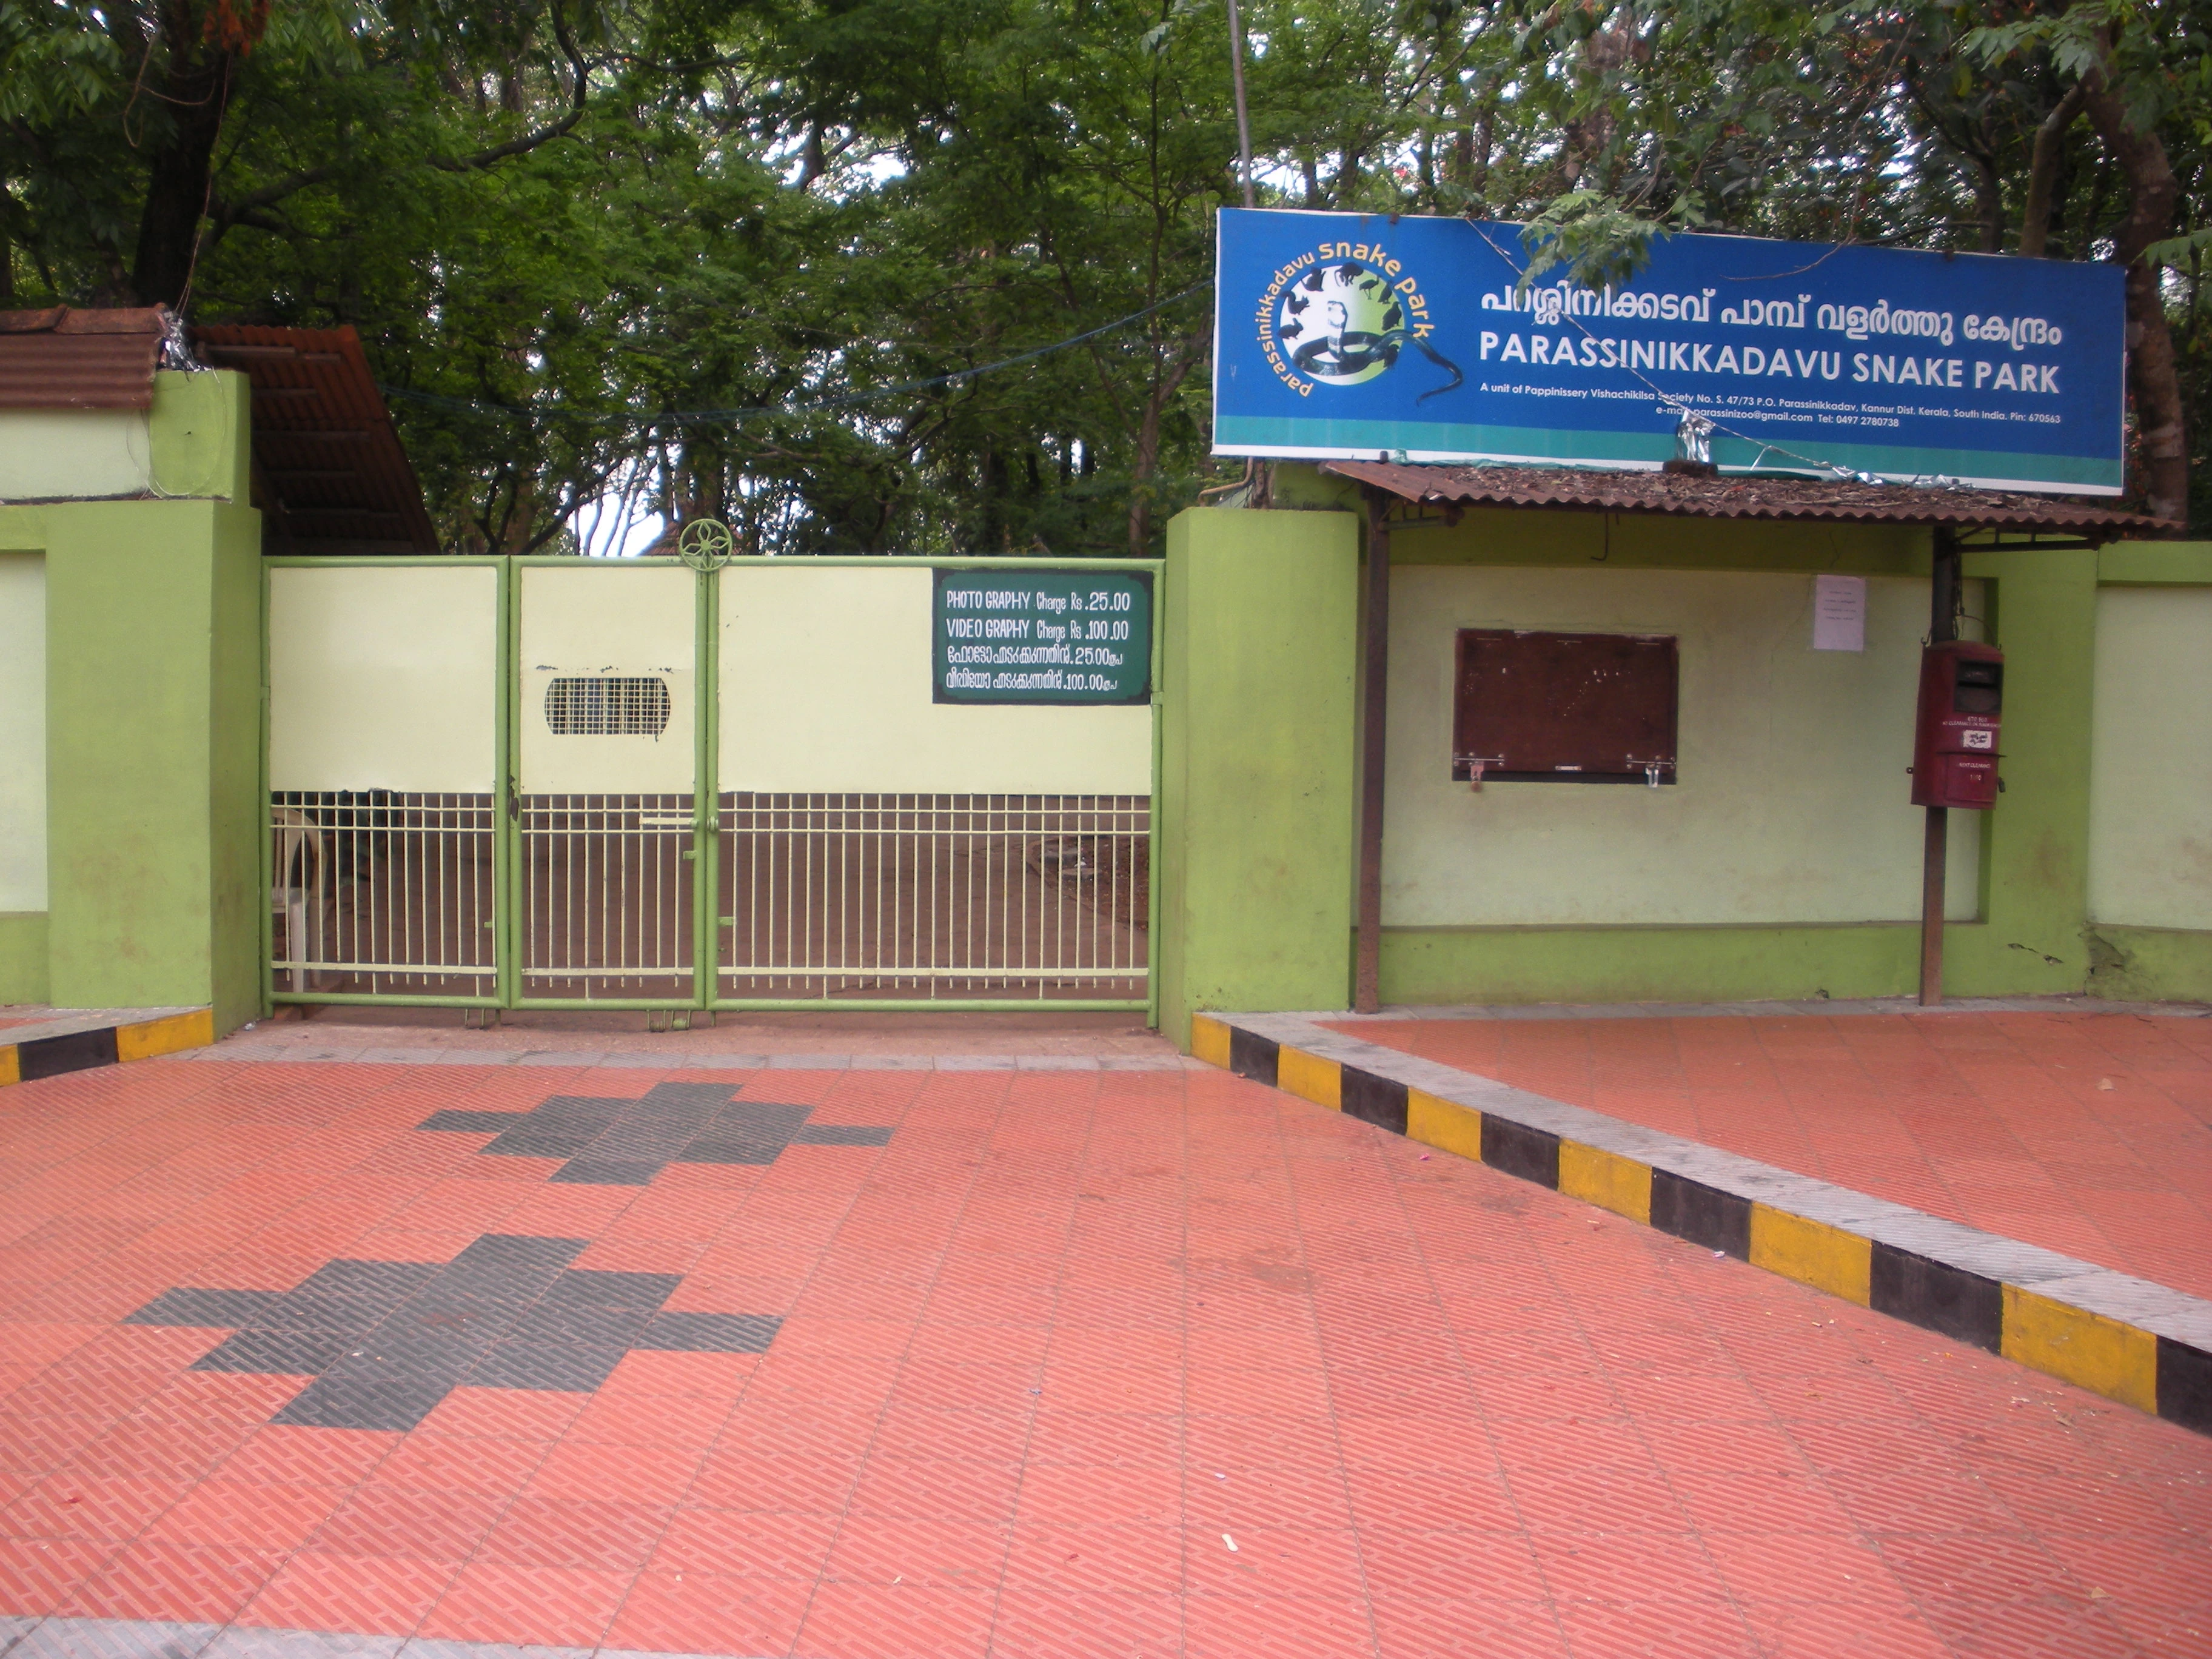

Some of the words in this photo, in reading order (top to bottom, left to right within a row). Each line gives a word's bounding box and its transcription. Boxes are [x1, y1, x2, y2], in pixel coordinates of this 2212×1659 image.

[1319, 241, 1401, 276] snake
[1721, 293, 1812, 329] പാമ്പ്
[1963, 313, 2062, 351] കേന്ദ്രം
[1480, 330, 1841, 381] PARASSINIKKADAVU
[1852, 352, 1963, 388] SNAKE
[1975, 361, 2060, 394] PARK
[1480, 383, 1489, 392] A
[1491, 384, 1510, 393] unit
[1512, 384, 1523, 394] of
[1525, 385, 1587, 400] Pappinissery
[1697, 394, 1713, 404] No.
[1716, 395, 1724, 404] S.
[1726, 396, 1754, 406] 47/73
[1757, 398, 1775, 407] P.O.
[1779, 399, 1858, 412] Parassinikkadav,
[1862, 403, 1894, 414] Kannur
[1897, 405, 1915, 415] Dist.
[1919, 406, 1951, 418] Kerala,
[1954, 408, 1980, 418] South
[1982, 411, 2008, 421] India.
[2010, 412, 2026, 422] Pin:
[2028, 414, 2060, 424] 670563
[1818, 415, 1834, 424] Tel:
[1836, 416, 1858, 425] 0497
[1861, 417, 1899, 427] 2780738
[946, 591, 982, 609] PHOTO
[985, 591, 1031, 609] GRAPHY
[1036, 592, 1067, 614] Charge
[946, 618, 982, 638] VIDEO
[985, 619, 1030, 638] GRAPHY
[1036, 620, 1066, 643] Charge
